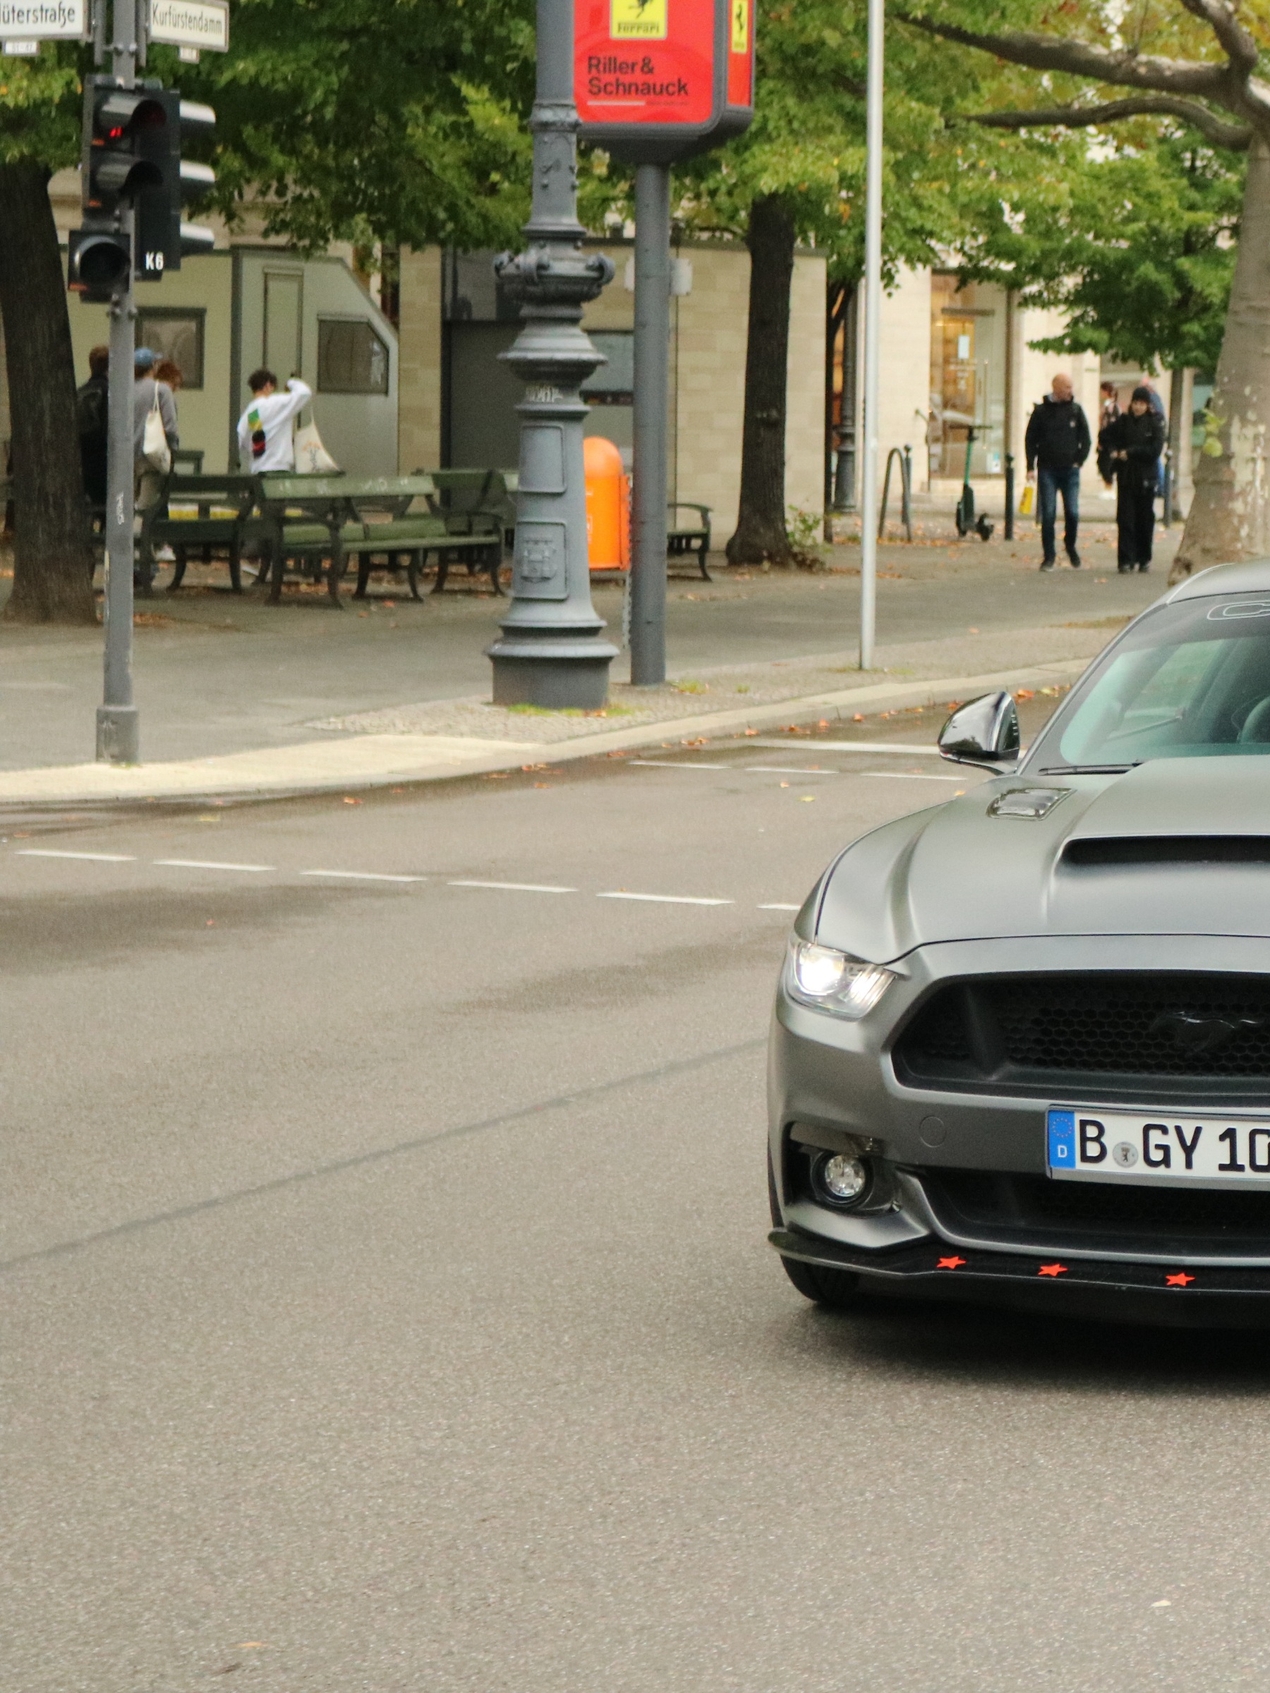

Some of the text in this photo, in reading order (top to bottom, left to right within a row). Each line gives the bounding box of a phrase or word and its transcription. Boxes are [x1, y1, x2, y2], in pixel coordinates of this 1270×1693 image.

[152, 2, 222, 35] Kurfürstendamm
[617, 22, 660, 34] Ferrari
[588, 56, 654, 75] Riller &
[588, 77, 689, 96] Schnauck
[145, 251, 164, 270] K6
[1057, 1145, 1068, 1158] D
[1079, 1119, 1107, 1164] B
[1142, 1123, 1203, 1170] GY
